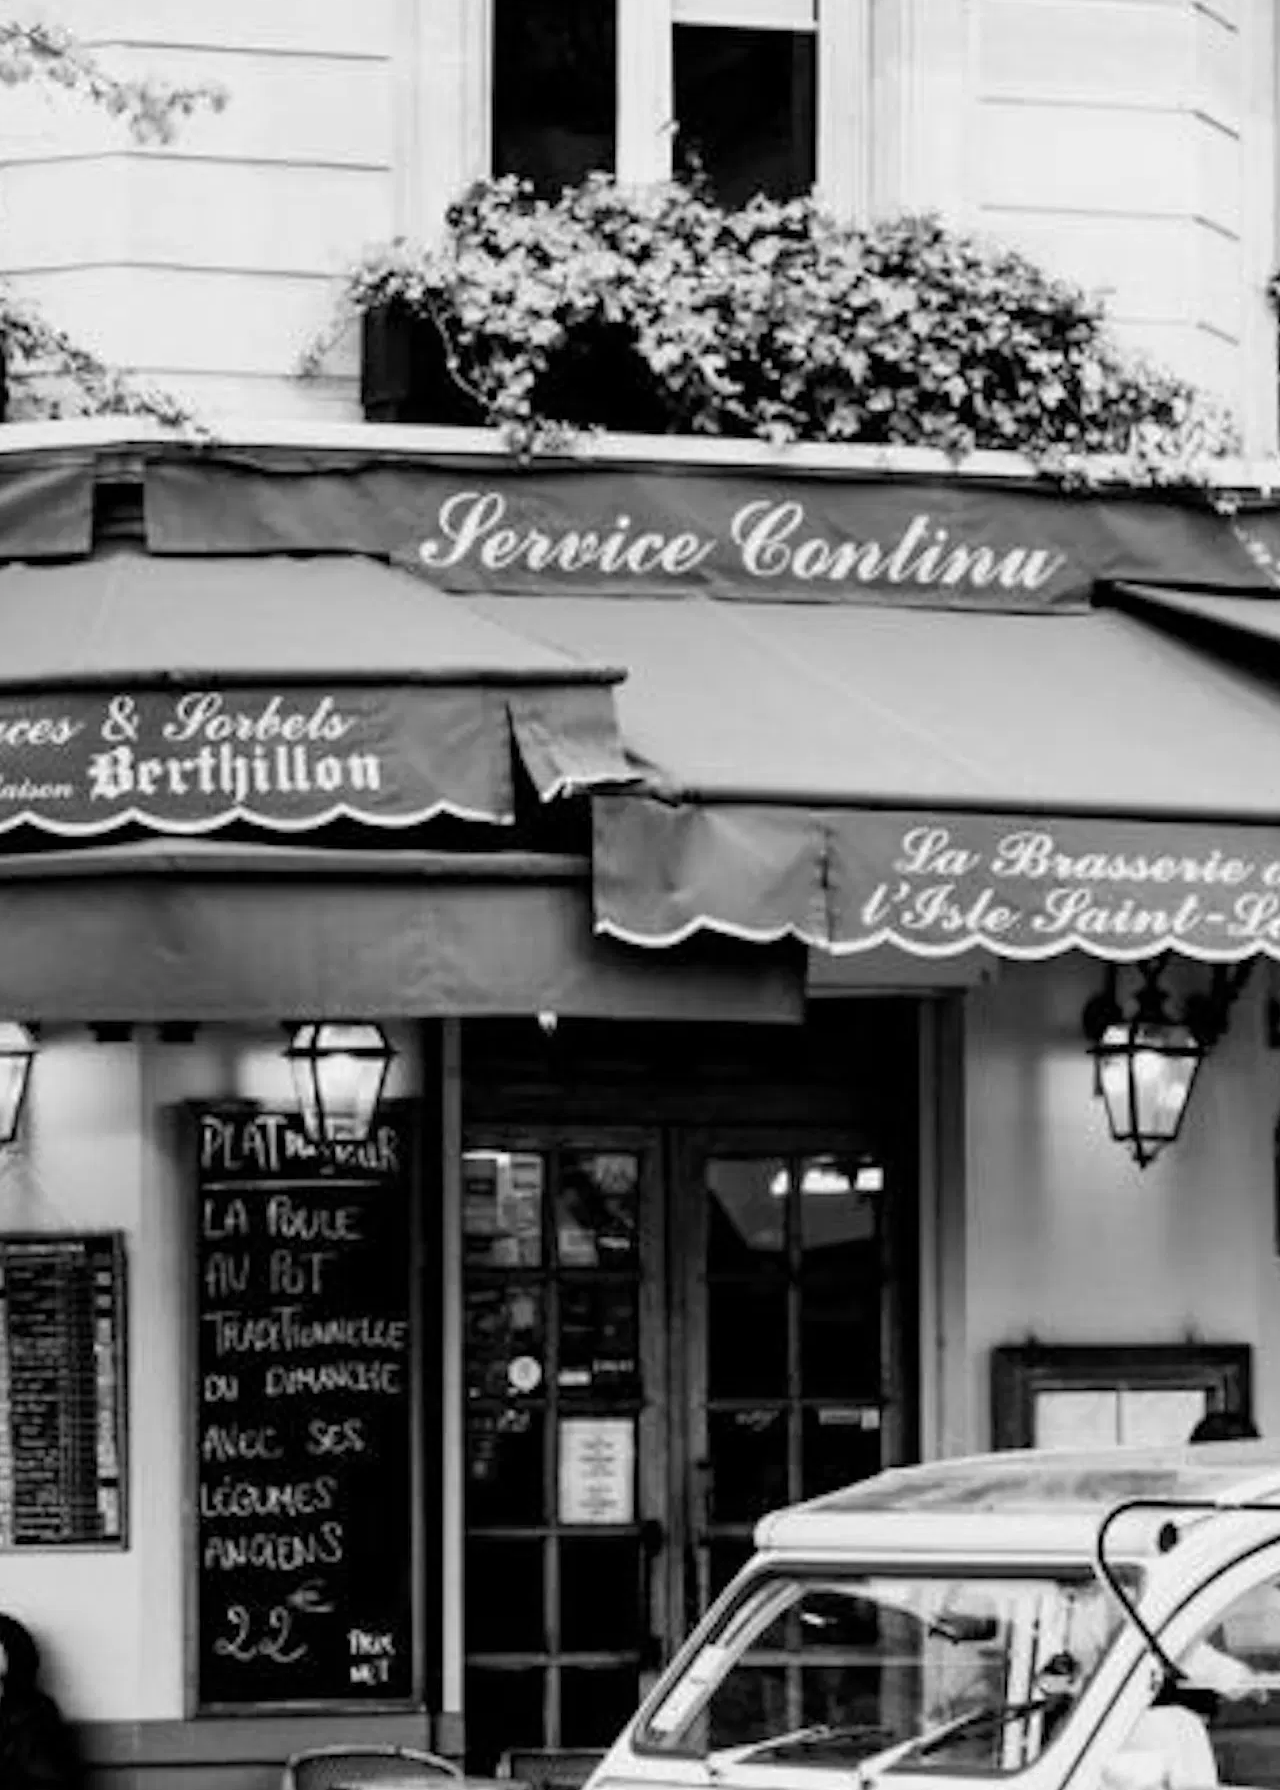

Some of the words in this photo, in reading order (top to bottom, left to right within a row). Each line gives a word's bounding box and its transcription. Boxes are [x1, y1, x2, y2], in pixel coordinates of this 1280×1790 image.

[420, 492, 716, 572] Service
[730, 499, 1067, 589] Continu
[101, 695, 139, 743] &
[163, 692, 357, 742] Sorbets
[88, 743, 380, 807] Berthillon
[893, 826, 982, 878] La
[990, 830, 1254, 886] Brasserie
[201, 1113, 287, 1172] PLAT
[204, 1197, 249, 1241] LA
[266, 1194, 365, 1241] POULE
[204, 1251, 250, 1299] AU
[270, 1248, 340, 1296] POT
[264, 1360, 402, 1397] DIMANCHE
[202, 1421, 285, 1462] AVEC
[306, 1417, 366, 1456] SES
[204, 1521, 344, 1571] ANCIENS
